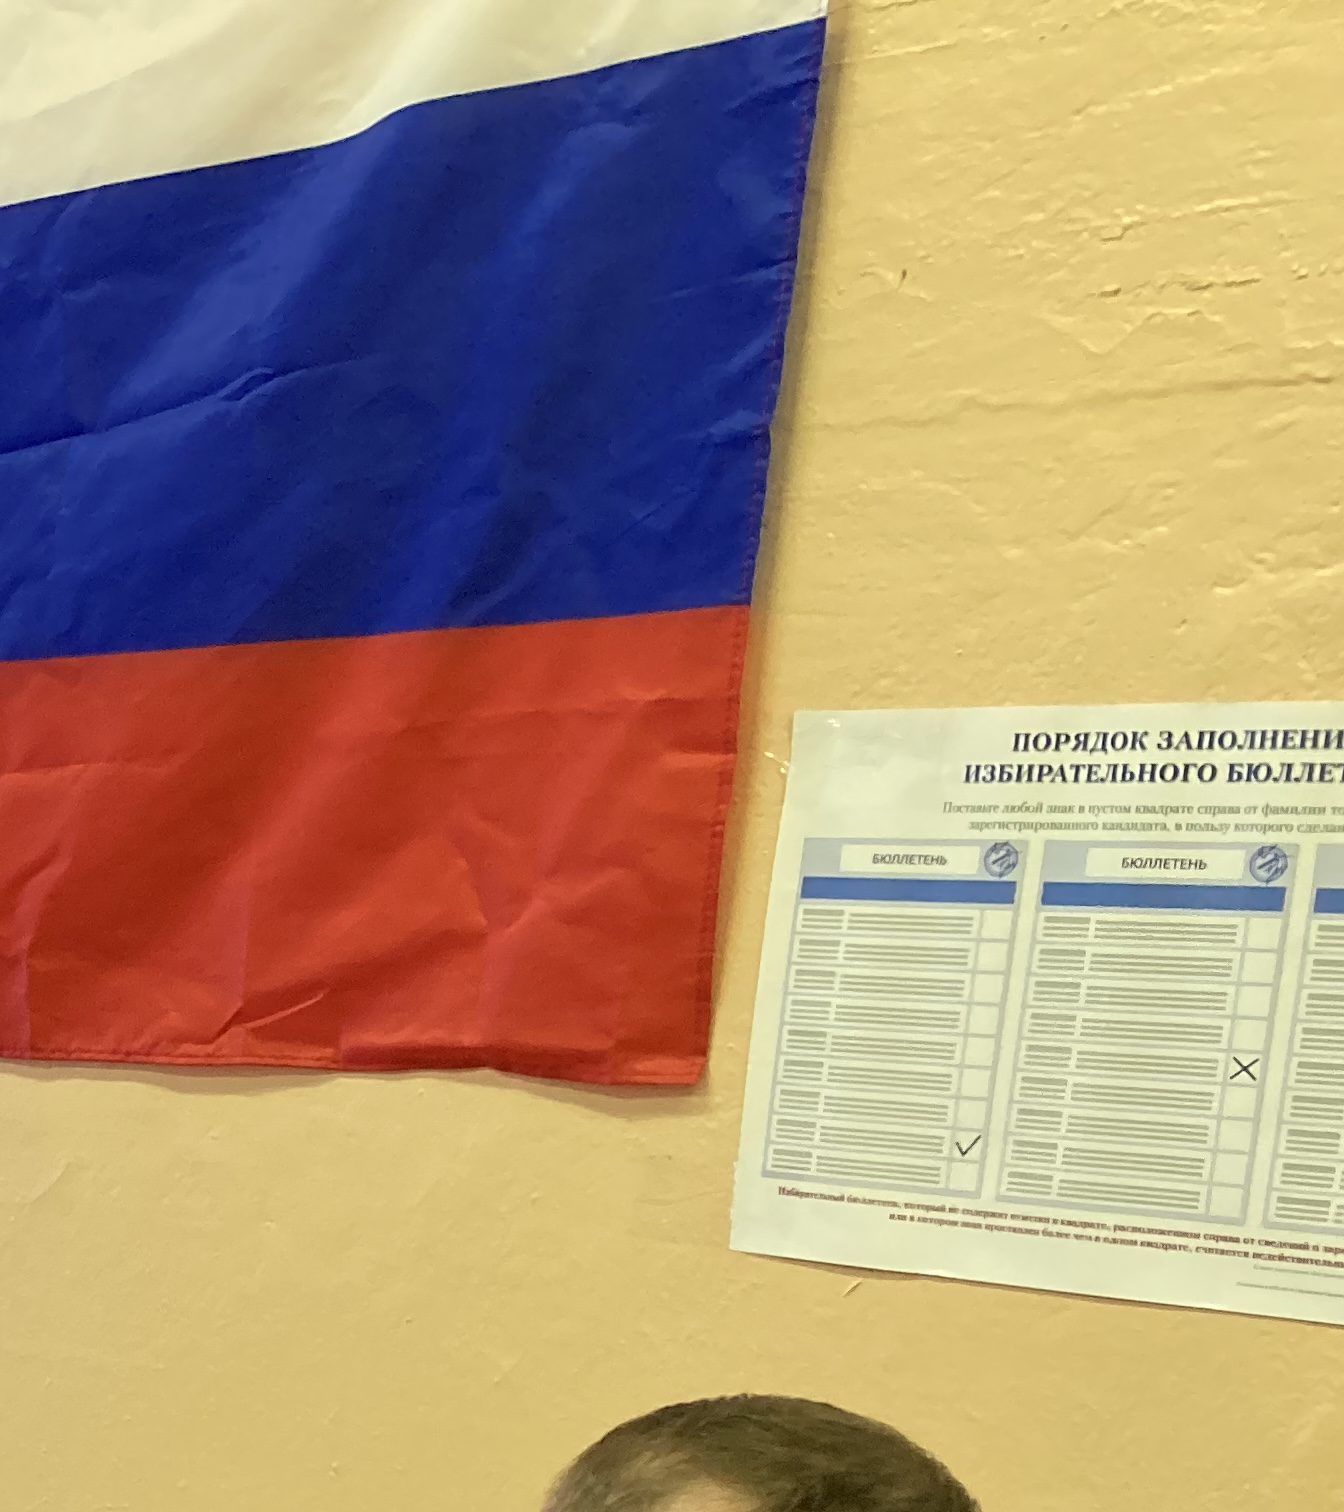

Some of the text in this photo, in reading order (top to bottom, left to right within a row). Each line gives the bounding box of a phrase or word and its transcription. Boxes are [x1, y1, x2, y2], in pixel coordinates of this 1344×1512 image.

[1012, 729, 1344, 755] ПОРЯДОК ЗАПОЛНЕНИ
[963, 762, 1218, 784] ИЗБИРАТЕЛЬНОГО
[1001, 801, 1043, 815] любой
[1046, 804, 1075, 814] знак
[1078, 804, 1086, 814] в
[1088, 804, 1132, 818] пустом
[1135, 804, 1194, 817] квадрате
[1197, 804, 1241, 818] справа
[1244, 804, 1259, 815] от
[1261, 802, 1326, 818] фамилии
[968, 820, 1099, 834] зарегистрированного
[1185, 821, 1230, 836] пользу
[1233, 821, 1294, 836] которого
[872, 853, 948, 867] БЮЛЛЕТЕНЬ
[1121, 856, 1208, 871] БЮЛЛЕТЕНЬ
